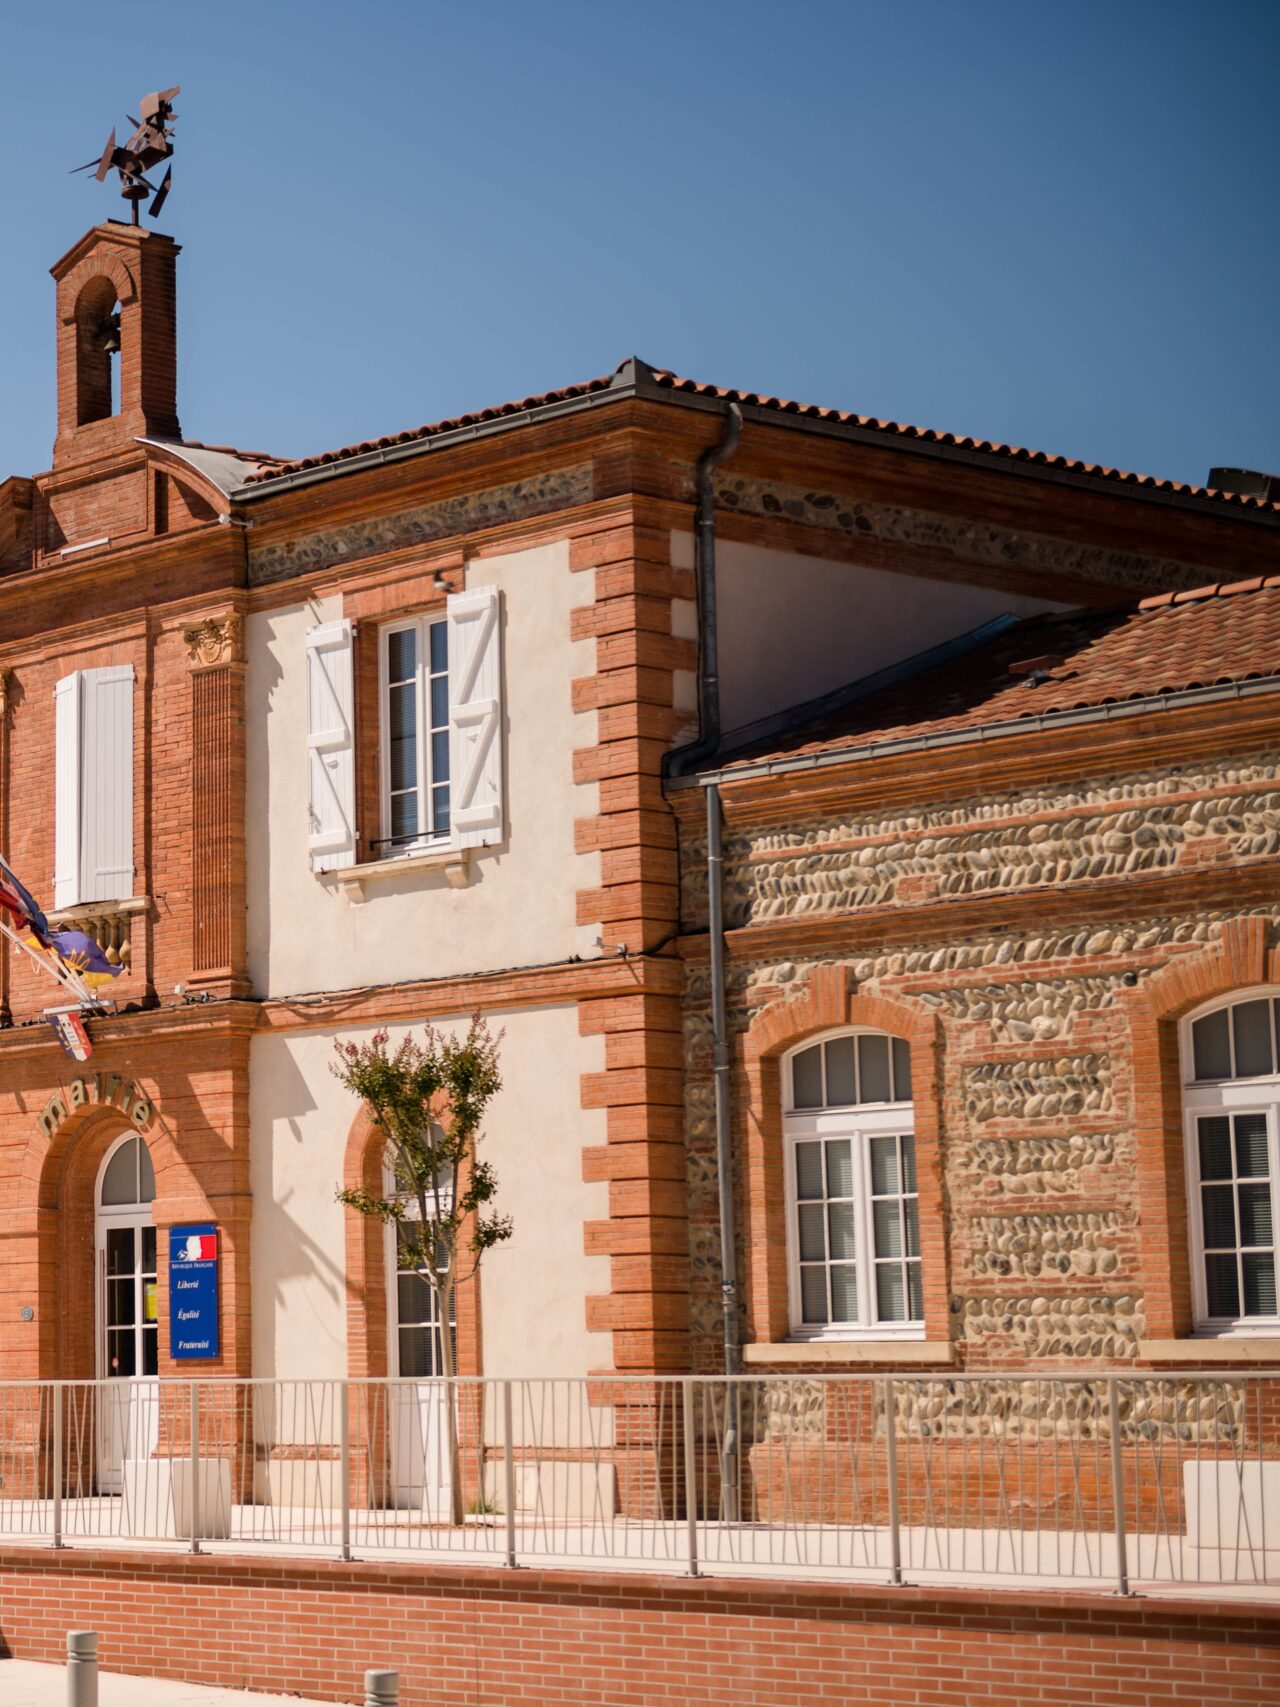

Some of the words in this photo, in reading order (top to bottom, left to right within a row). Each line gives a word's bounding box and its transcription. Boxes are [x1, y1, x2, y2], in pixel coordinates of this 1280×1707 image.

[37, 1073, 151, 1138] mairie
[177, 1280, 199, 1289] Liberté
[177, 1308, 200, 1321] Égalité
[178, 1340, 210, 1350] Fraternité
